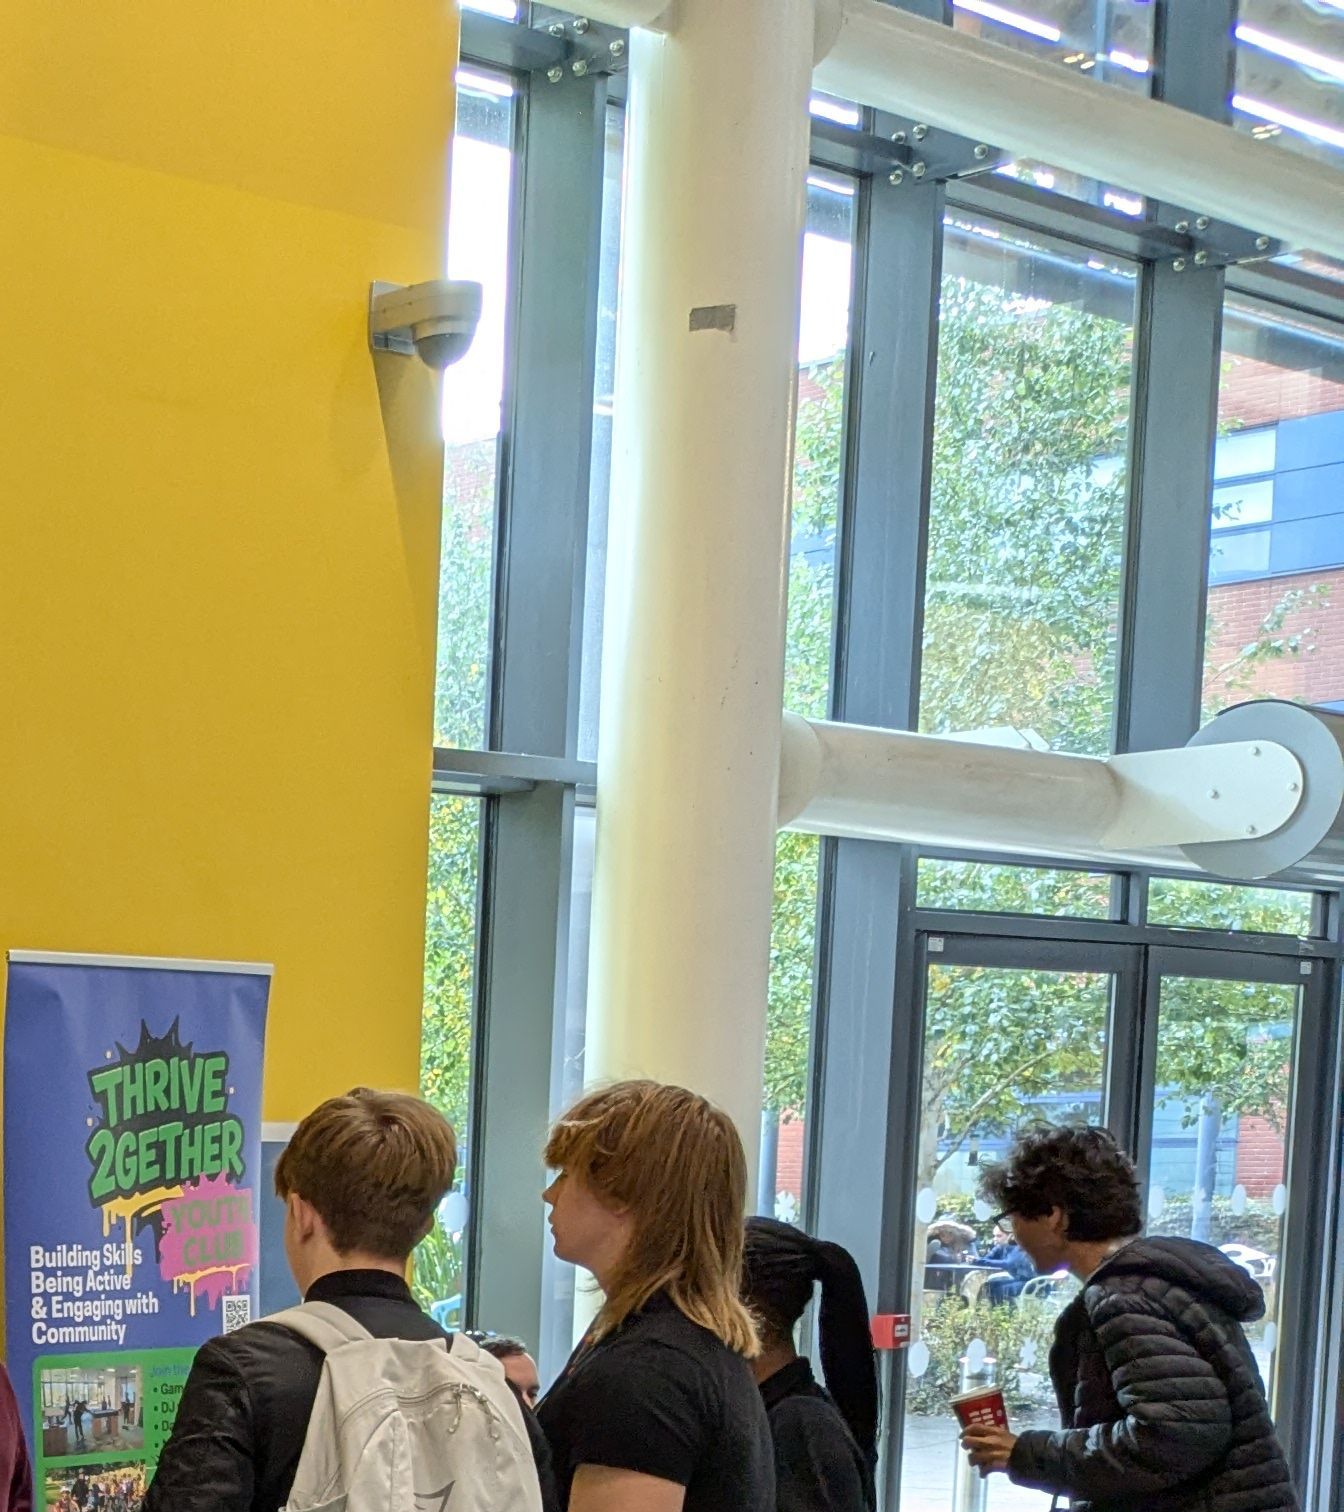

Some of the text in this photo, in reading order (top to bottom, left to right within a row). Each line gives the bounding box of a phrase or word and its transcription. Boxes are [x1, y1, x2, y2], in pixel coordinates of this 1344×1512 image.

[93, 1057, 226, 1125] THRIVE
[89, 1121, 244, 1200] 2GETHER
[172, 1196, 249, 1232] YOUTH
[30, 1243, 142, 1269] Building Skills
[183, 1231, 243, 1267] CLUB
[31, 1269, 131, 1295] Being Active
[31, 1294, 158, 1322] & Engaging with
[32, 1322, 126, 1345] Community
[161, 1383, 183, 1395] Gam
[161, 1402, 175, 1413] DJ
